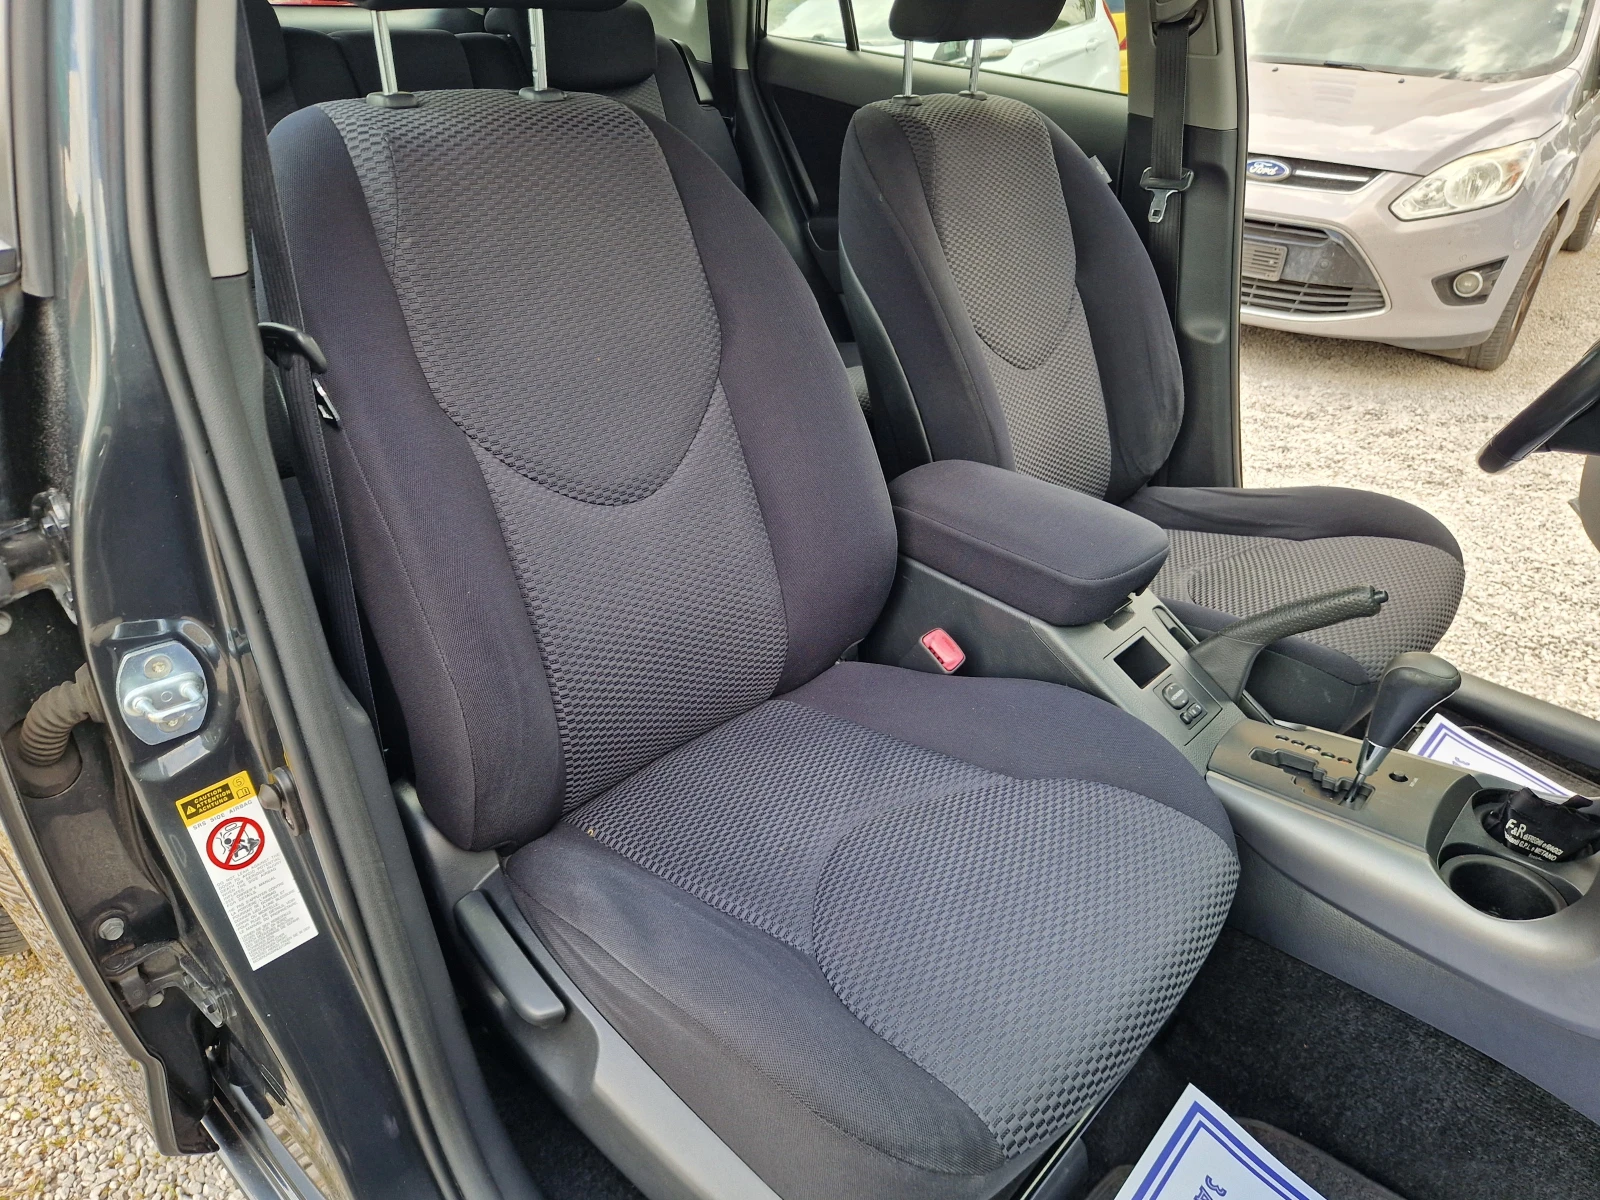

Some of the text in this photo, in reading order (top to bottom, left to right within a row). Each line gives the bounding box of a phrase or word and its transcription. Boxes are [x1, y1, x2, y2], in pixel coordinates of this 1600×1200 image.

[1249, 161, 1279, 176] Ford
[235, 777, 242, 786] 5
[193, 787, 222, 804] CAUTION
[195, 789, 231, 808] ATTENTION
[197, 796, 228, 813] ACHTUNG
[192, 799, 253, 830] SRS SIDE AIRBAG
